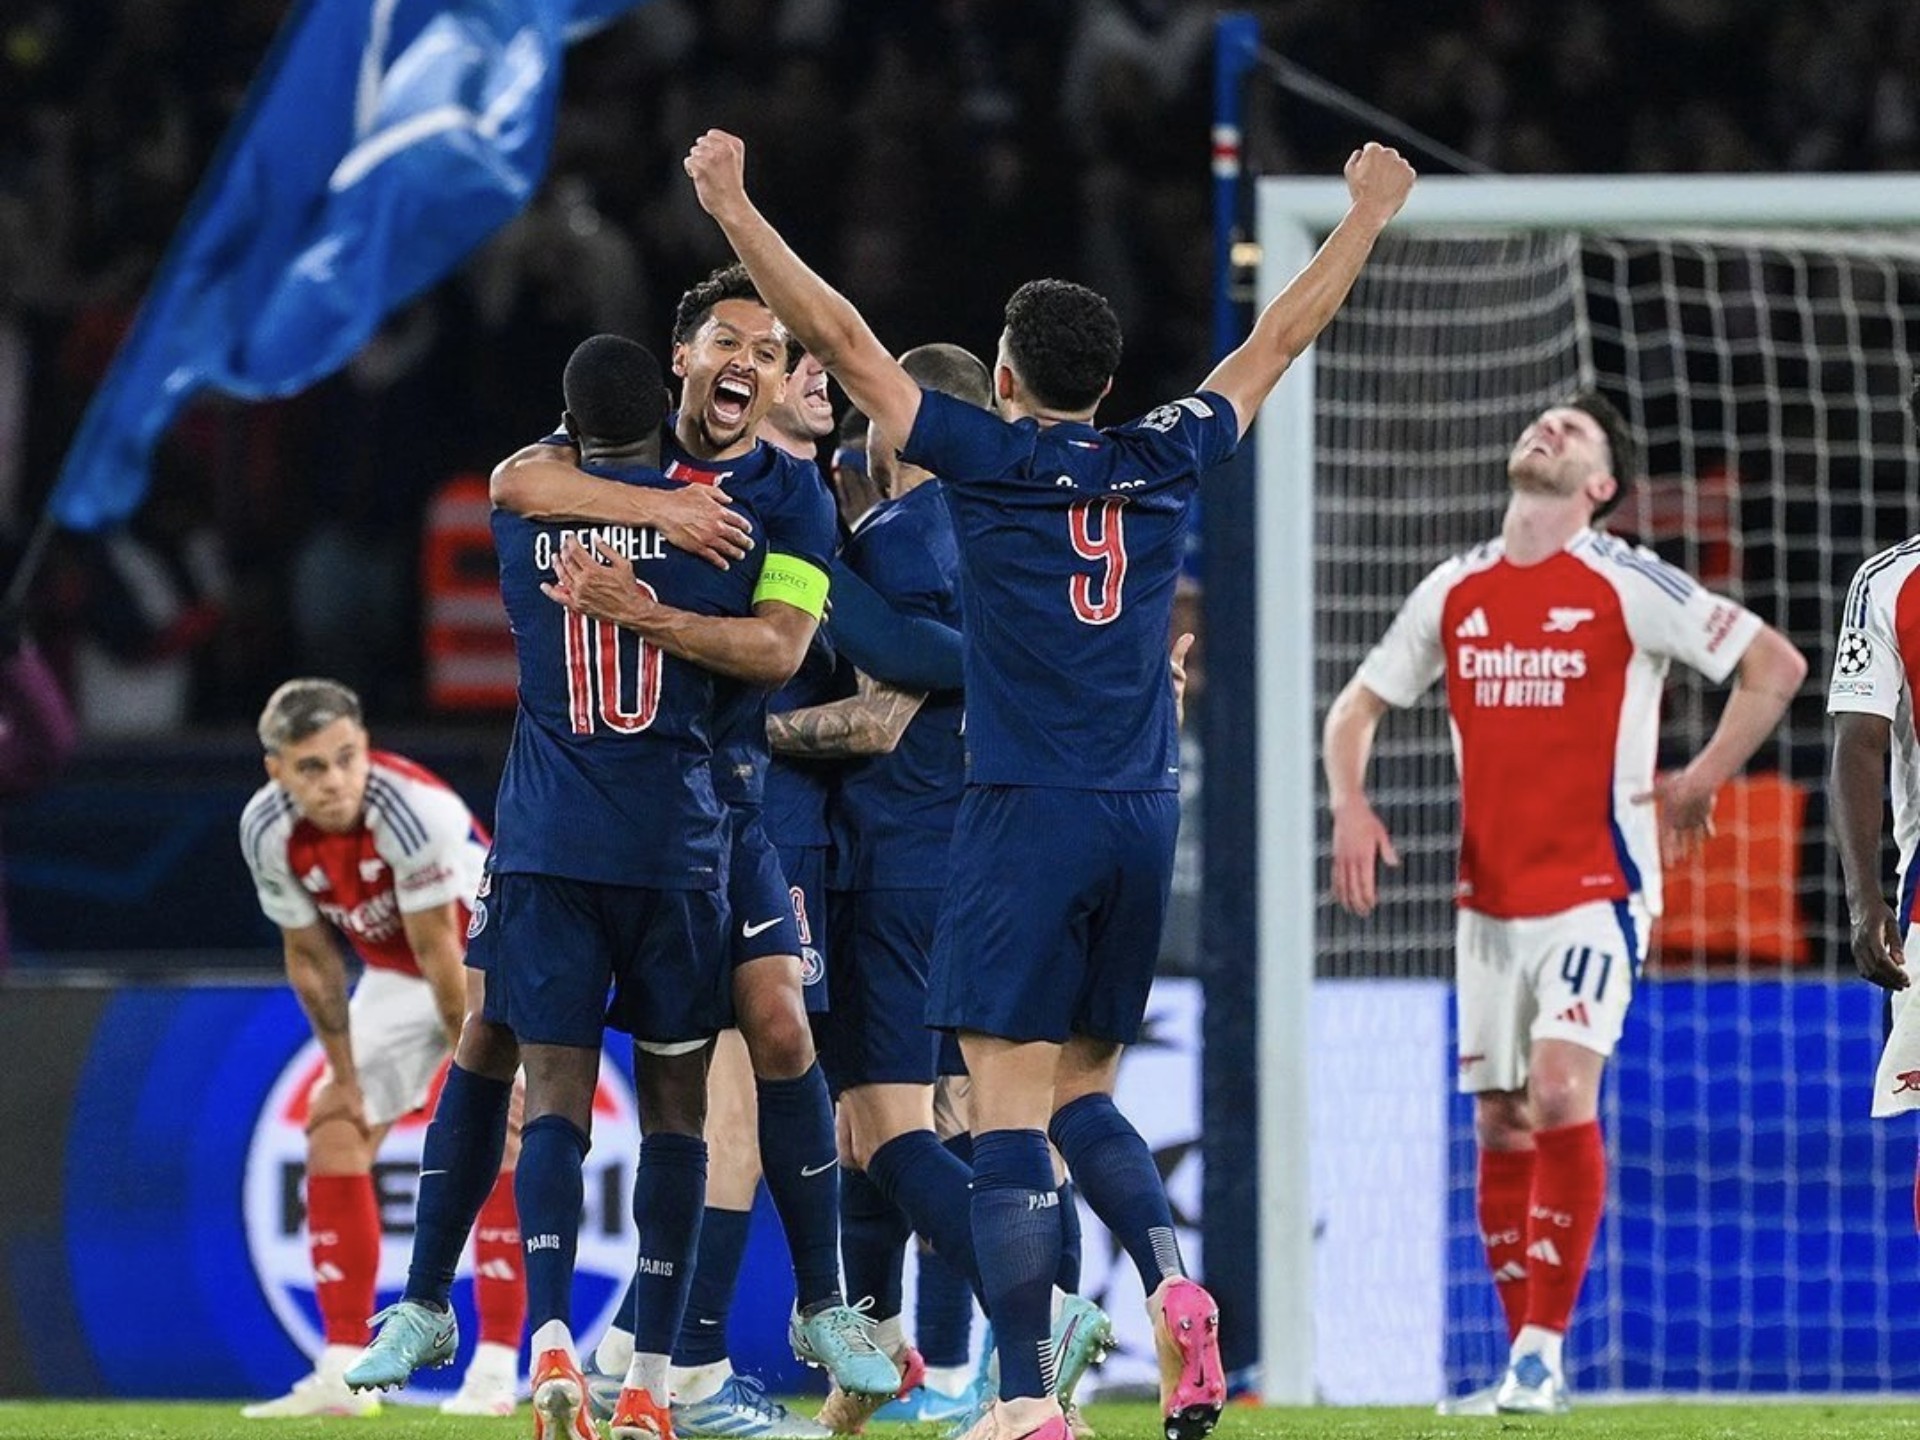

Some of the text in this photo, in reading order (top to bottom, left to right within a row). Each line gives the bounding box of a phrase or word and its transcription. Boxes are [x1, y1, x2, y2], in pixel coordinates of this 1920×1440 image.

[1067, 494, 1129, 626] 9
[763, 571, 808, 590] RESPECT
[563, 578, 663, 735] 10
[1458, 641, 1587, 679] Emirates
[1475, 680, 1565, 707] FLY BETTER
[1561, 943, 1613, 1002] 41
[527, 1234, 560, 1253] PARIS
[639, 1257, 674, 1276] PARIS
